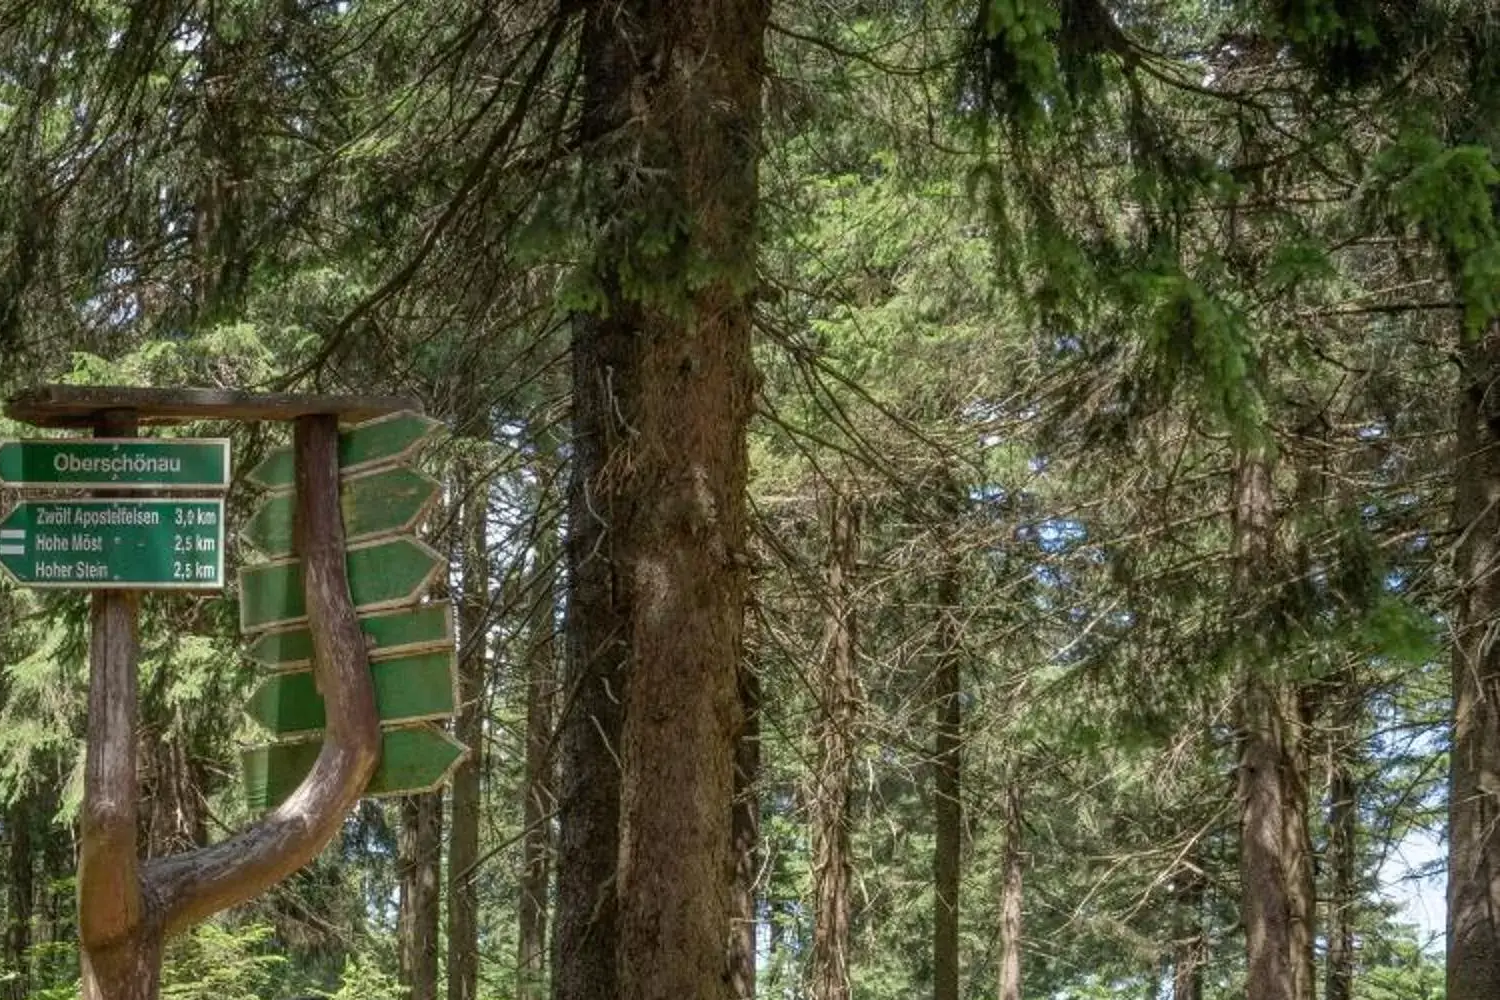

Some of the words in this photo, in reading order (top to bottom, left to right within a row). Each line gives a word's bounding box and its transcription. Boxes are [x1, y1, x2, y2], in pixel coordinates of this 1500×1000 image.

[53, 453, 181, 473] Oberschönau
[73, 508, 160, 528] Apostelfelsen
[197, 508, 217, 525] km
[35, 534, 69, 551] Hohe
[174, 535, 193, 553] 2,5
[195, 534, 215, 552] km
[35, 561, 73, 578] Hoher
[76, 561, 109, 578] Stein
[173, 561, 192, 580] 2,5
[195, 561, 215, 578] km
